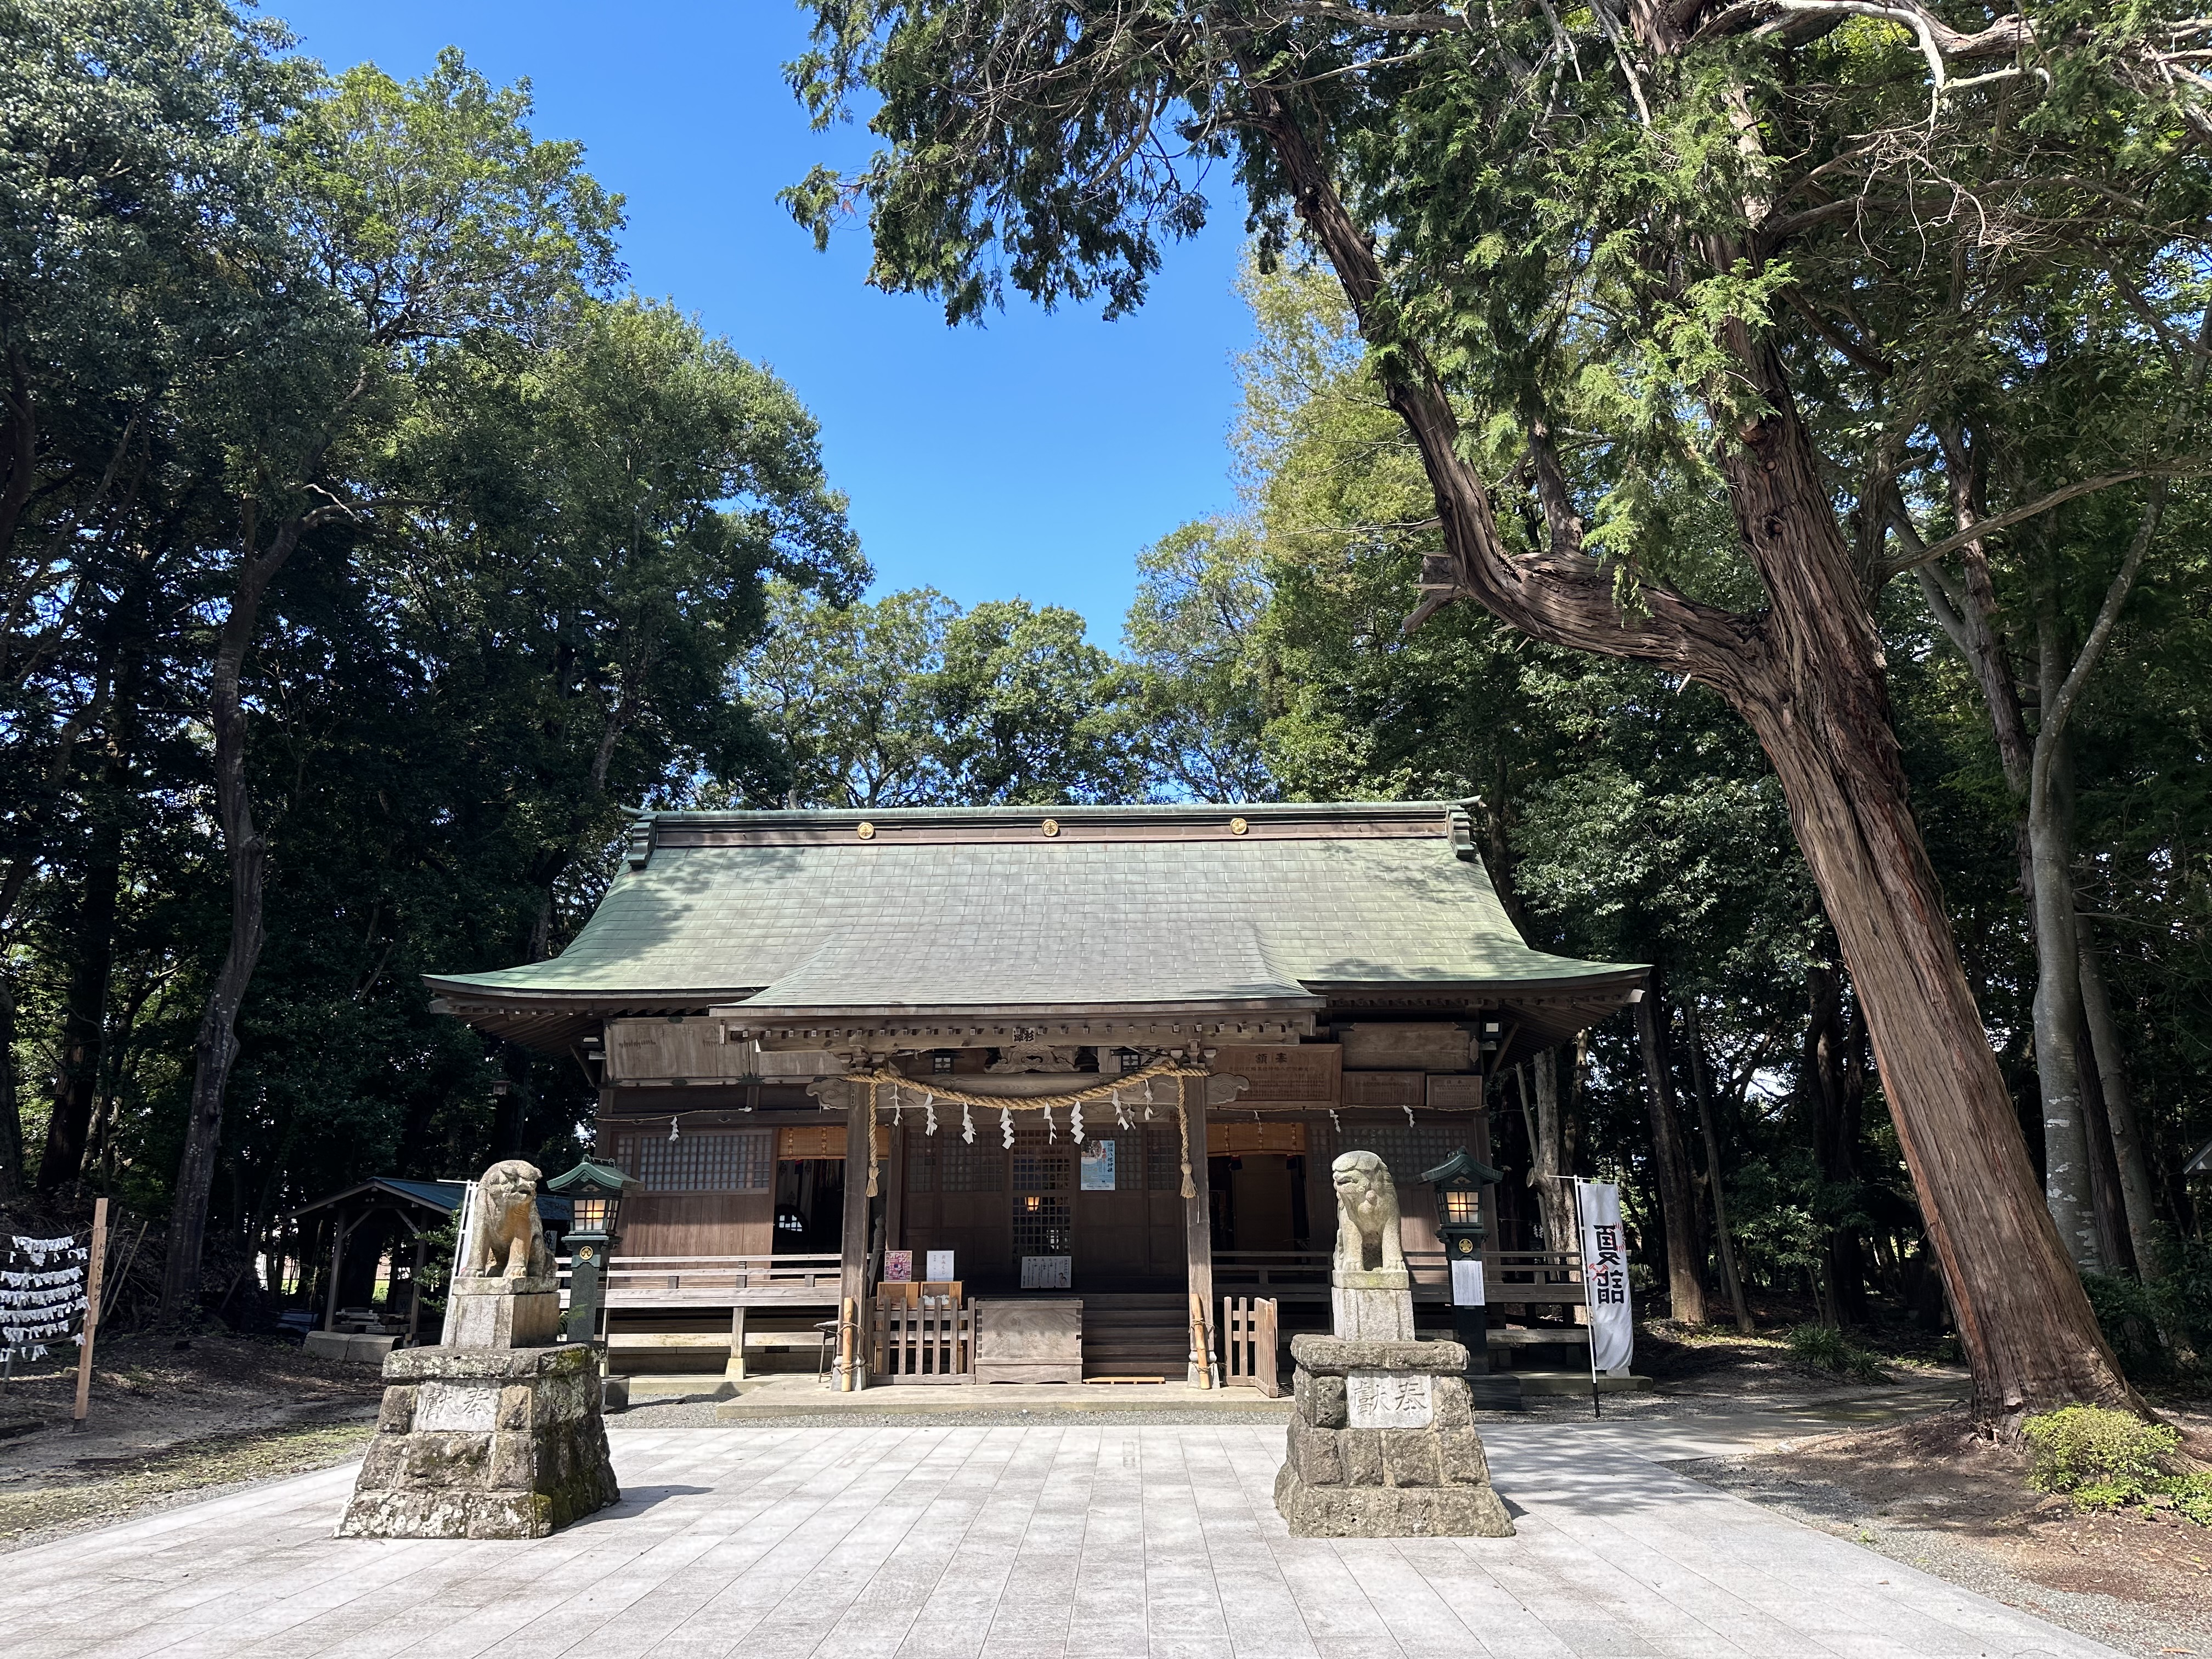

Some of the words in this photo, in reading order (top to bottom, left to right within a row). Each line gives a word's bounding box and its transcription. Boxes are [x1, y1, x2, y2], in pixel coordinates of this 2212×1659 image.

[94, 1243, 105, 1301] おみくじ結び
